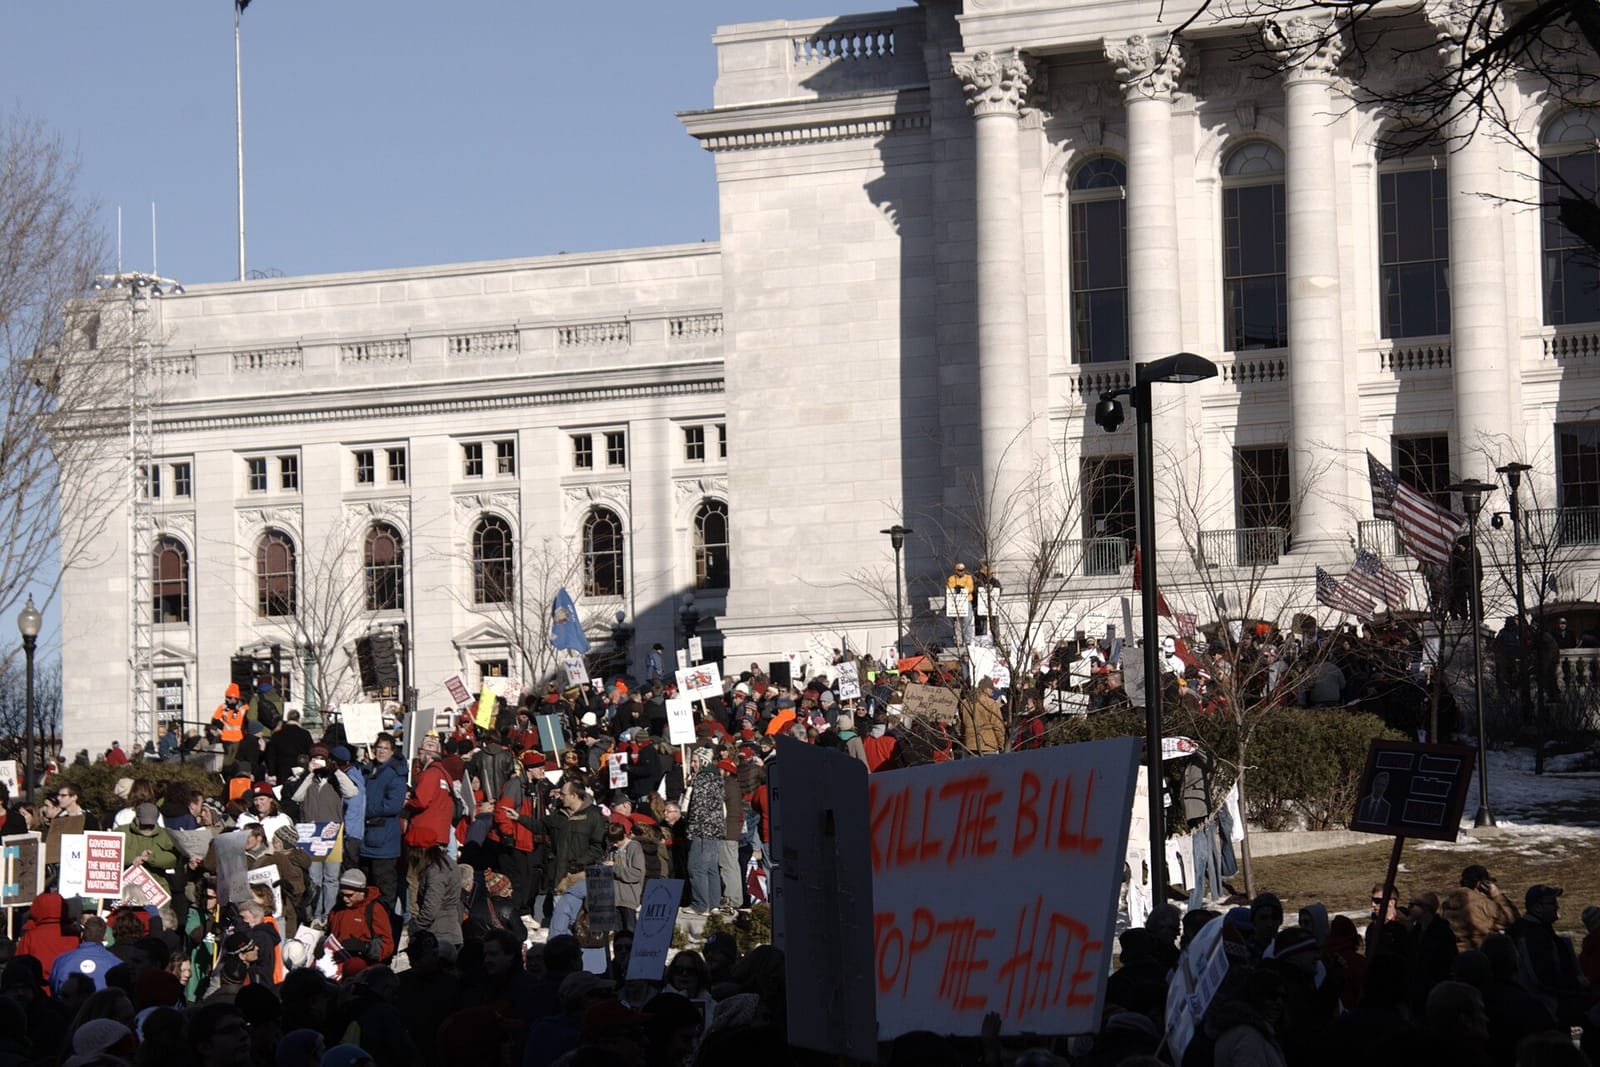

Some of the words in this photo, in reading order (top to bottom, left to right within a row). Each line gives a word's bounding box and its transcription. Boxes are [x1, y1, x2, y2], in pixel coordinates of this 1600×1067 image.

[868, 780, 943, 874] KILL
[939, 774, 1003, 866] THE
[1012, 767, 1104, 856] BILL
[88, 839, 120, 849] GOVERNOR
[91, 848, 118, 858] WALKER:
[88, 861, 99, 870] THE
[99, 861, 120, 871] WHOLE
[89, 870, 111, 880] WORLD
[111, 871, 118, 880] IS
[645, 903, 667, 918] MTI
[873, 907, 935, 998] TOP
[936, 917, 996, 1013] THE
[997, 892, 1104, 1022] HATE
